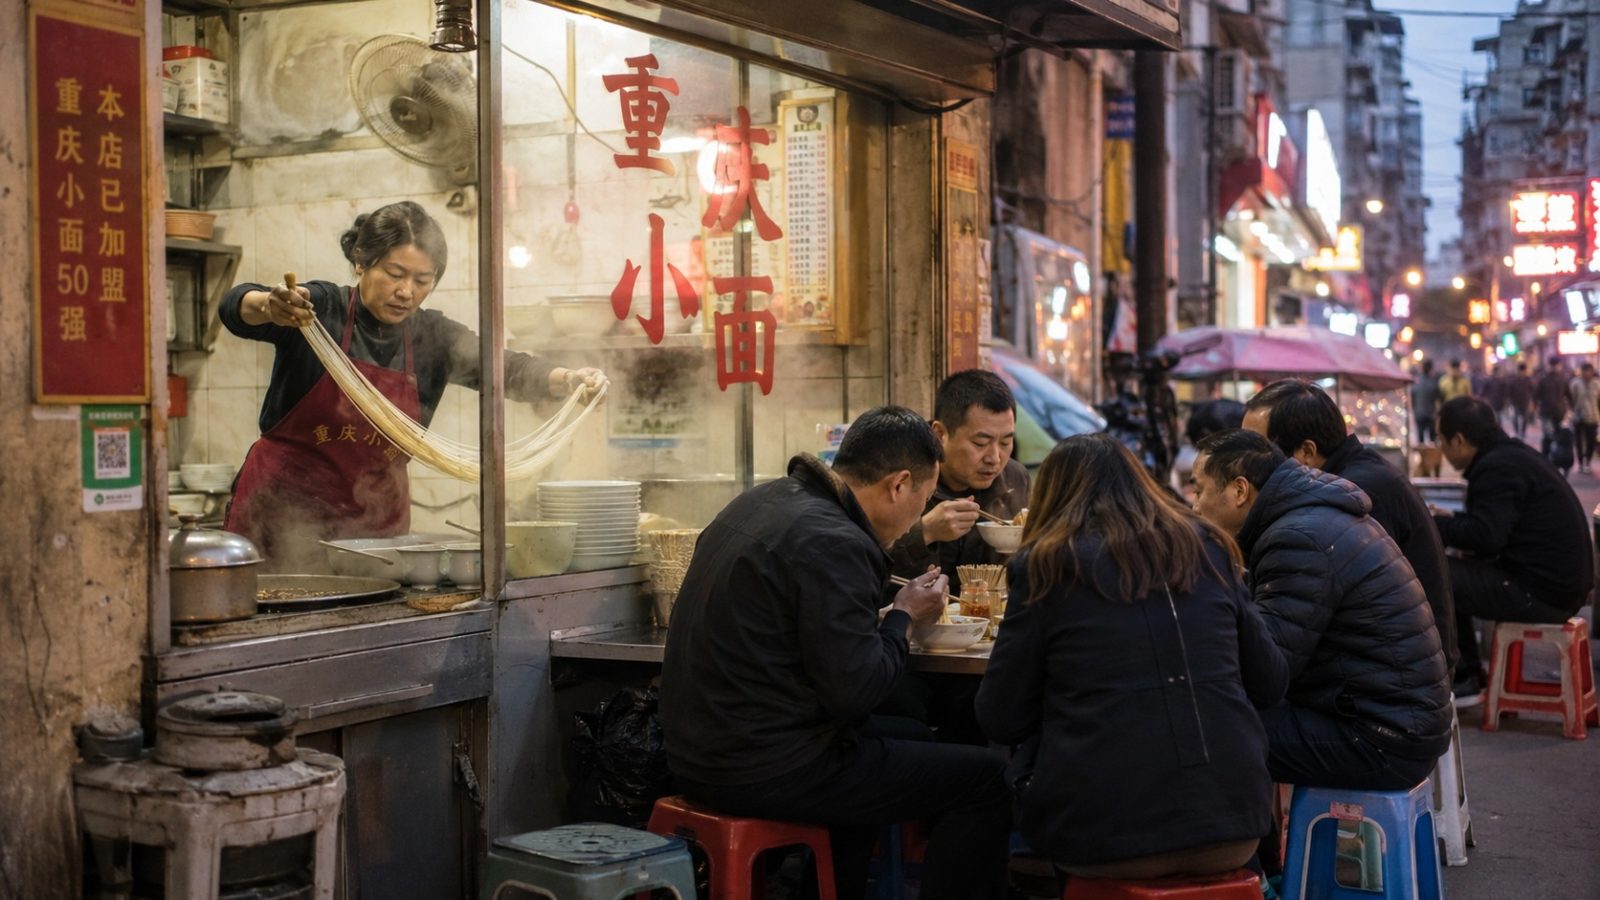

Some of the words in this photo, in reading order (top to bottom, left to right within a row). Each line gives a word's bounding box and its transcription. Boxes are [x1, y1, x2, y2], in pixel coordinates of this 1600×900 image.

[55, 78, 89, 341] 重庆小面50强
[96, 85, 127, 303] 本店已加盟
